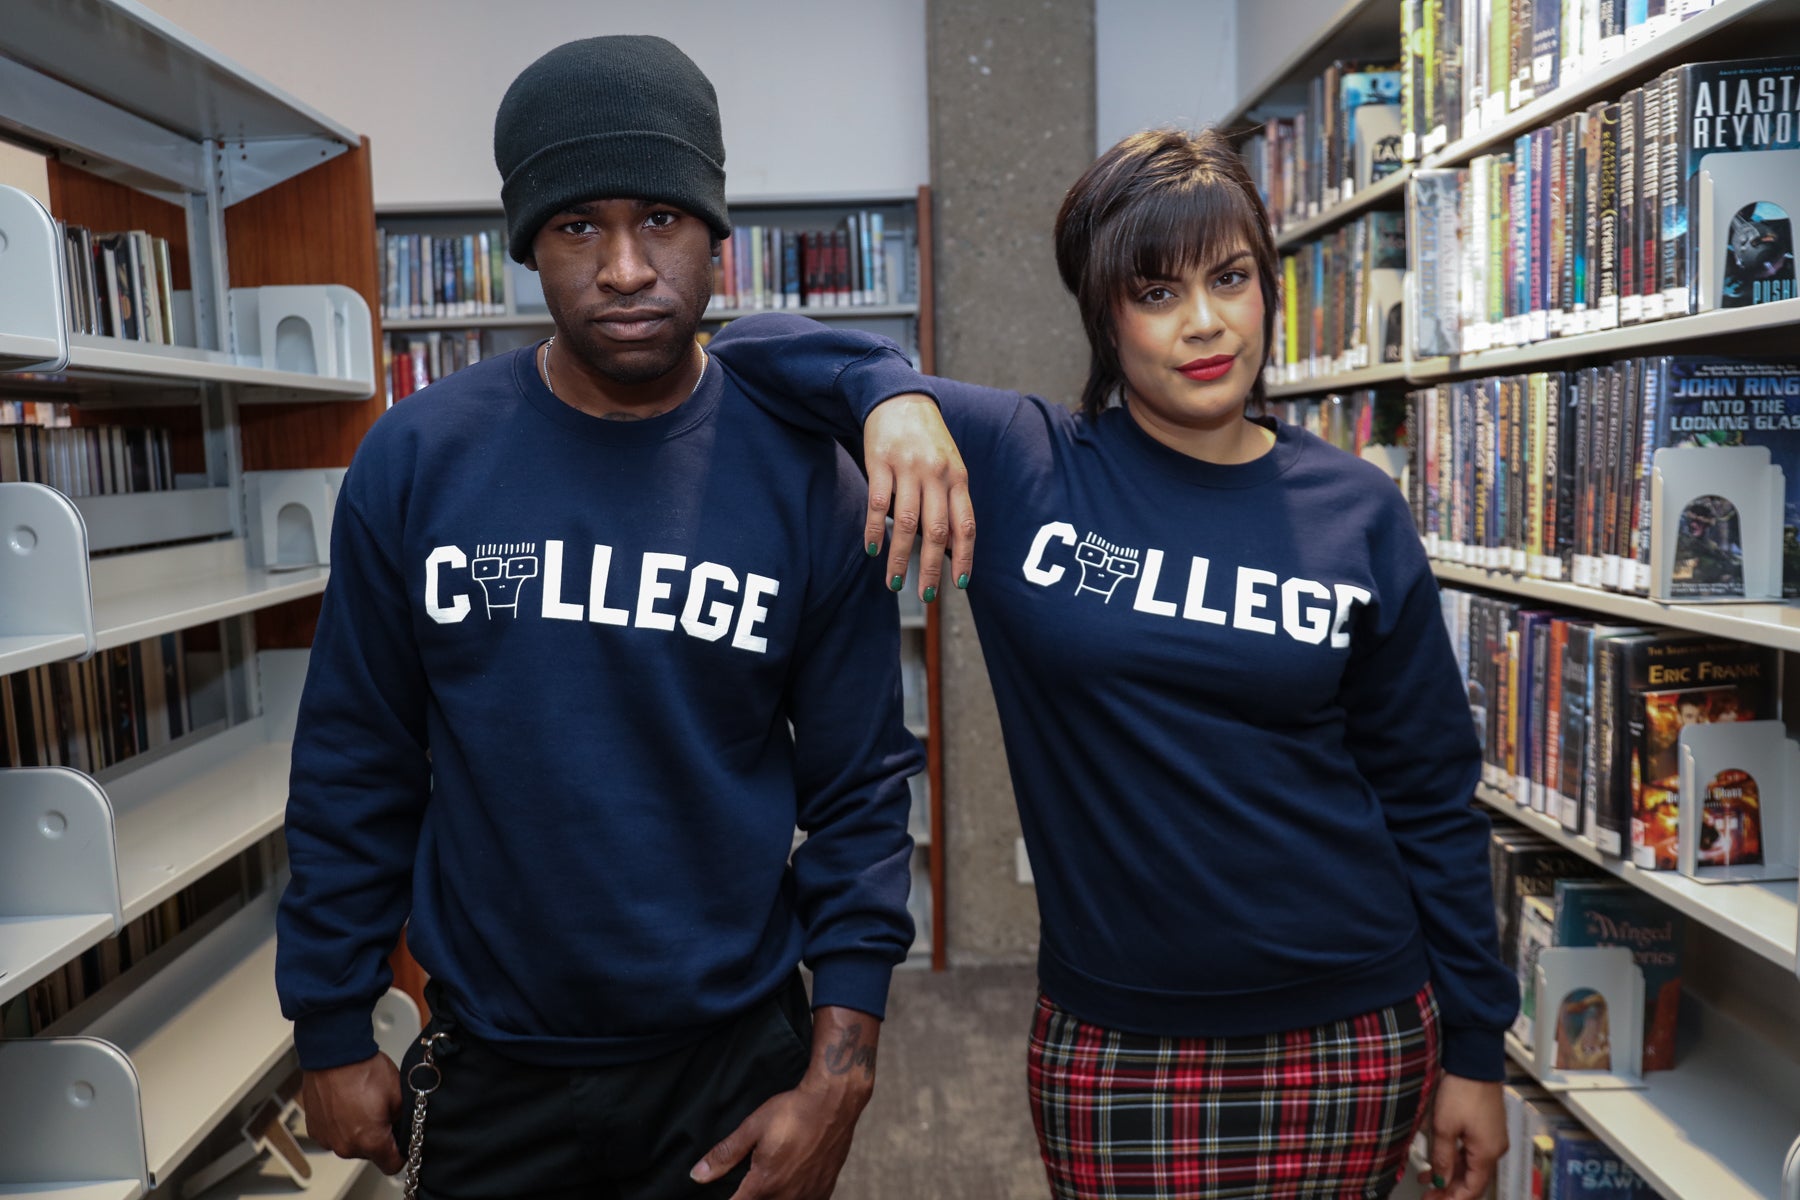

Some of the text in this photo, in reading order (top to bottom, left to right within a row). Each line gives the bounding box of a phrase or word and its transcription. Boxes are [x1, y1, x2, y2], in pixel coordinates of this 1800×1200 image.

[1693, 113, 1800, 149] REYNO
[1530, 259, 1541, 311] HOUS
[1546, 380, 1558, 422] JOHN
[1673, 377, 1738, 398] JOHN
[1701, 398, 1785, 415] INTO THE
[1640, 369, 1658, 476] JOHN RINGO
[1670, 415, 1750, 432] LOOKING
[1546, 424, 1557, 476] RINGO
